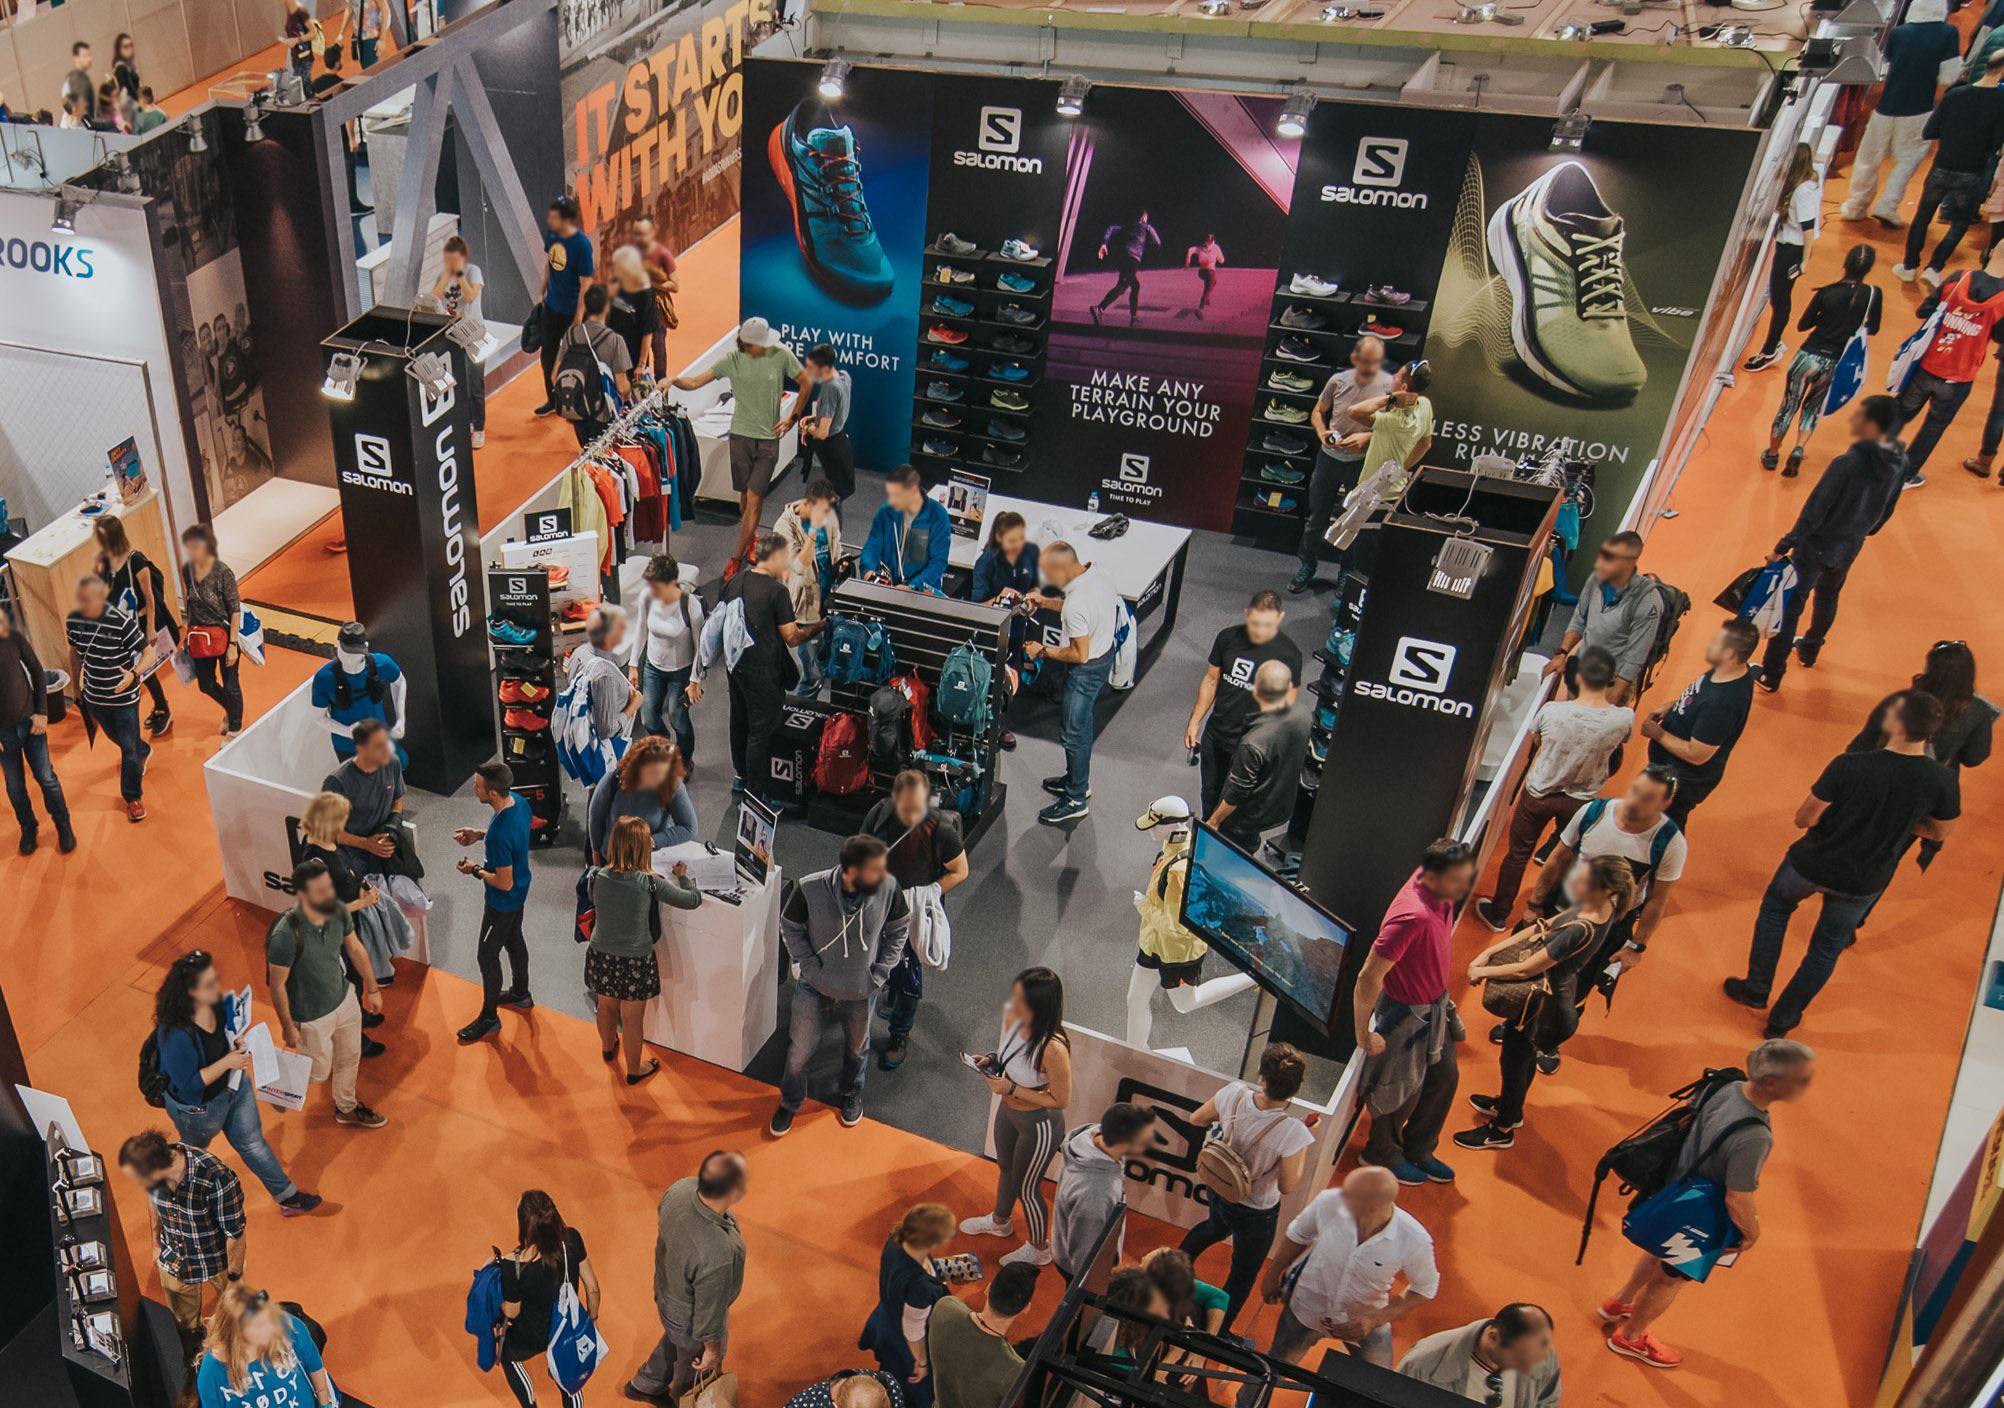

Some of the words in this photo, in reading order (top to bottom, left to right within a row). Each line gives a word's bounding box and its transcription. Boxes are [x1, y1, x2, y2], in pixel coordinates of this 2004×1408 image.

[575, 80, 617, 167] IT
[576, 106, 687, 235] WITH
[0, 236, 94, 279] OOKS
[781, 323, 822, 343] PLAY
[828, 329, 873, 351] WITH
[834, 348, 900, 371] MFORT
[1090, 369, 1150, 393] MAKE
[1156, 379, 1204, 400] ANY
[1070, 384, 1154, 412] TERRAIN
[1163, 397, 1221, 422] YOUR
[1071, 402, 1213, 438] PLAYGROUND
[1431, 420, 1483, 442] LESS
